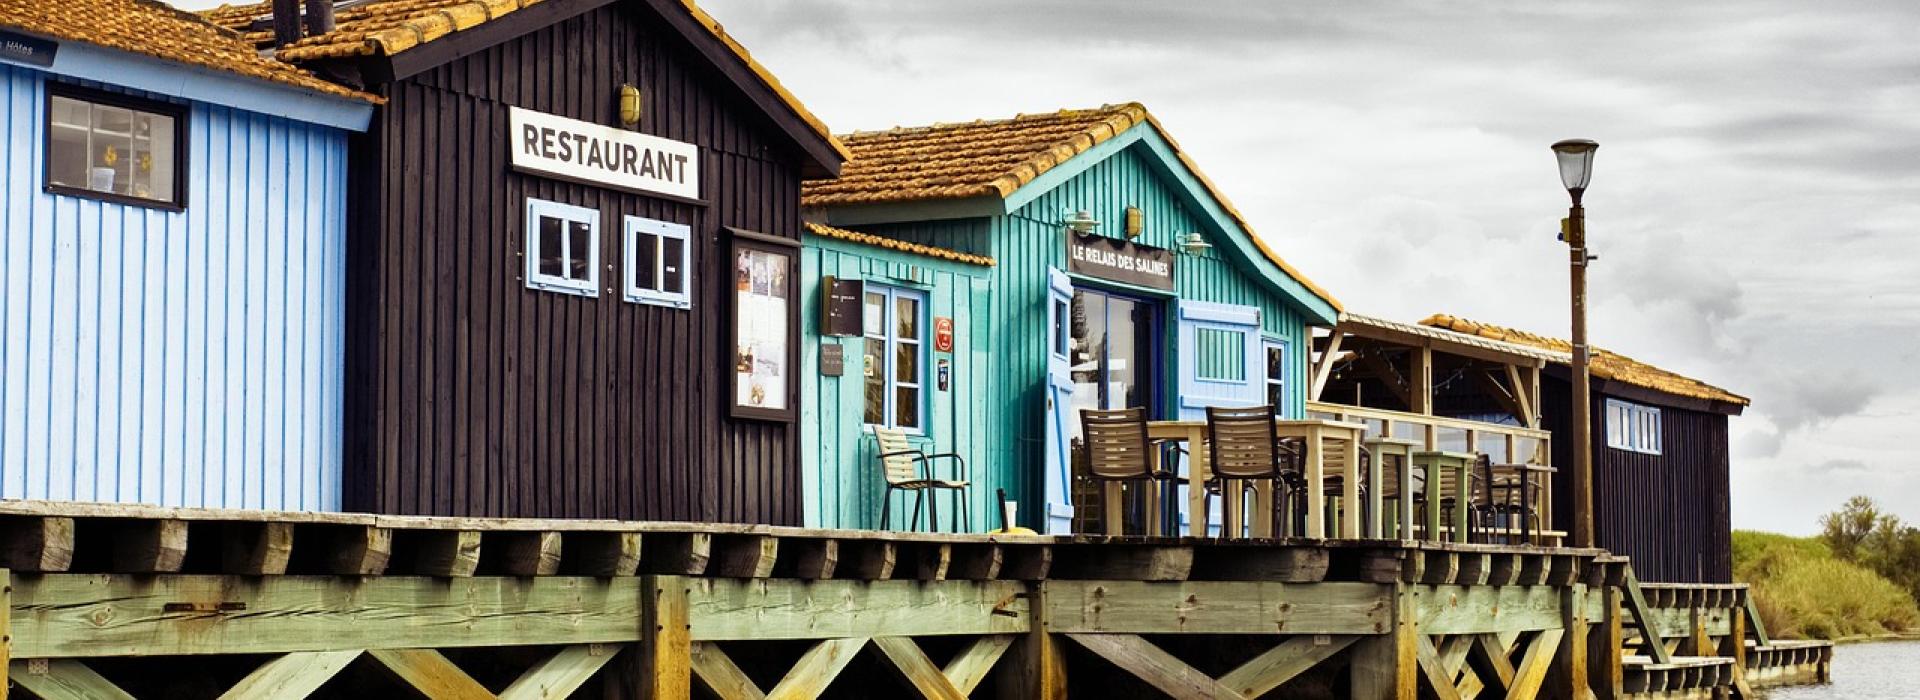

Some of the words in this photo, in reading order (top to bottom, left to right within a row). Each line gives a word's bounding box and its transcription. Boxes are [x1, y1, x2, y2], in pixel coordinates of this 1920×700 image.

[522, 123, 688, 184] RESTAURANT
[1072, 244, 1084, 260] LE
[1085, 247, 1117, 267] RELAIS
[1118, 255, 1134, 271] DES
[1135, 258, 1168, 277] SALINES
